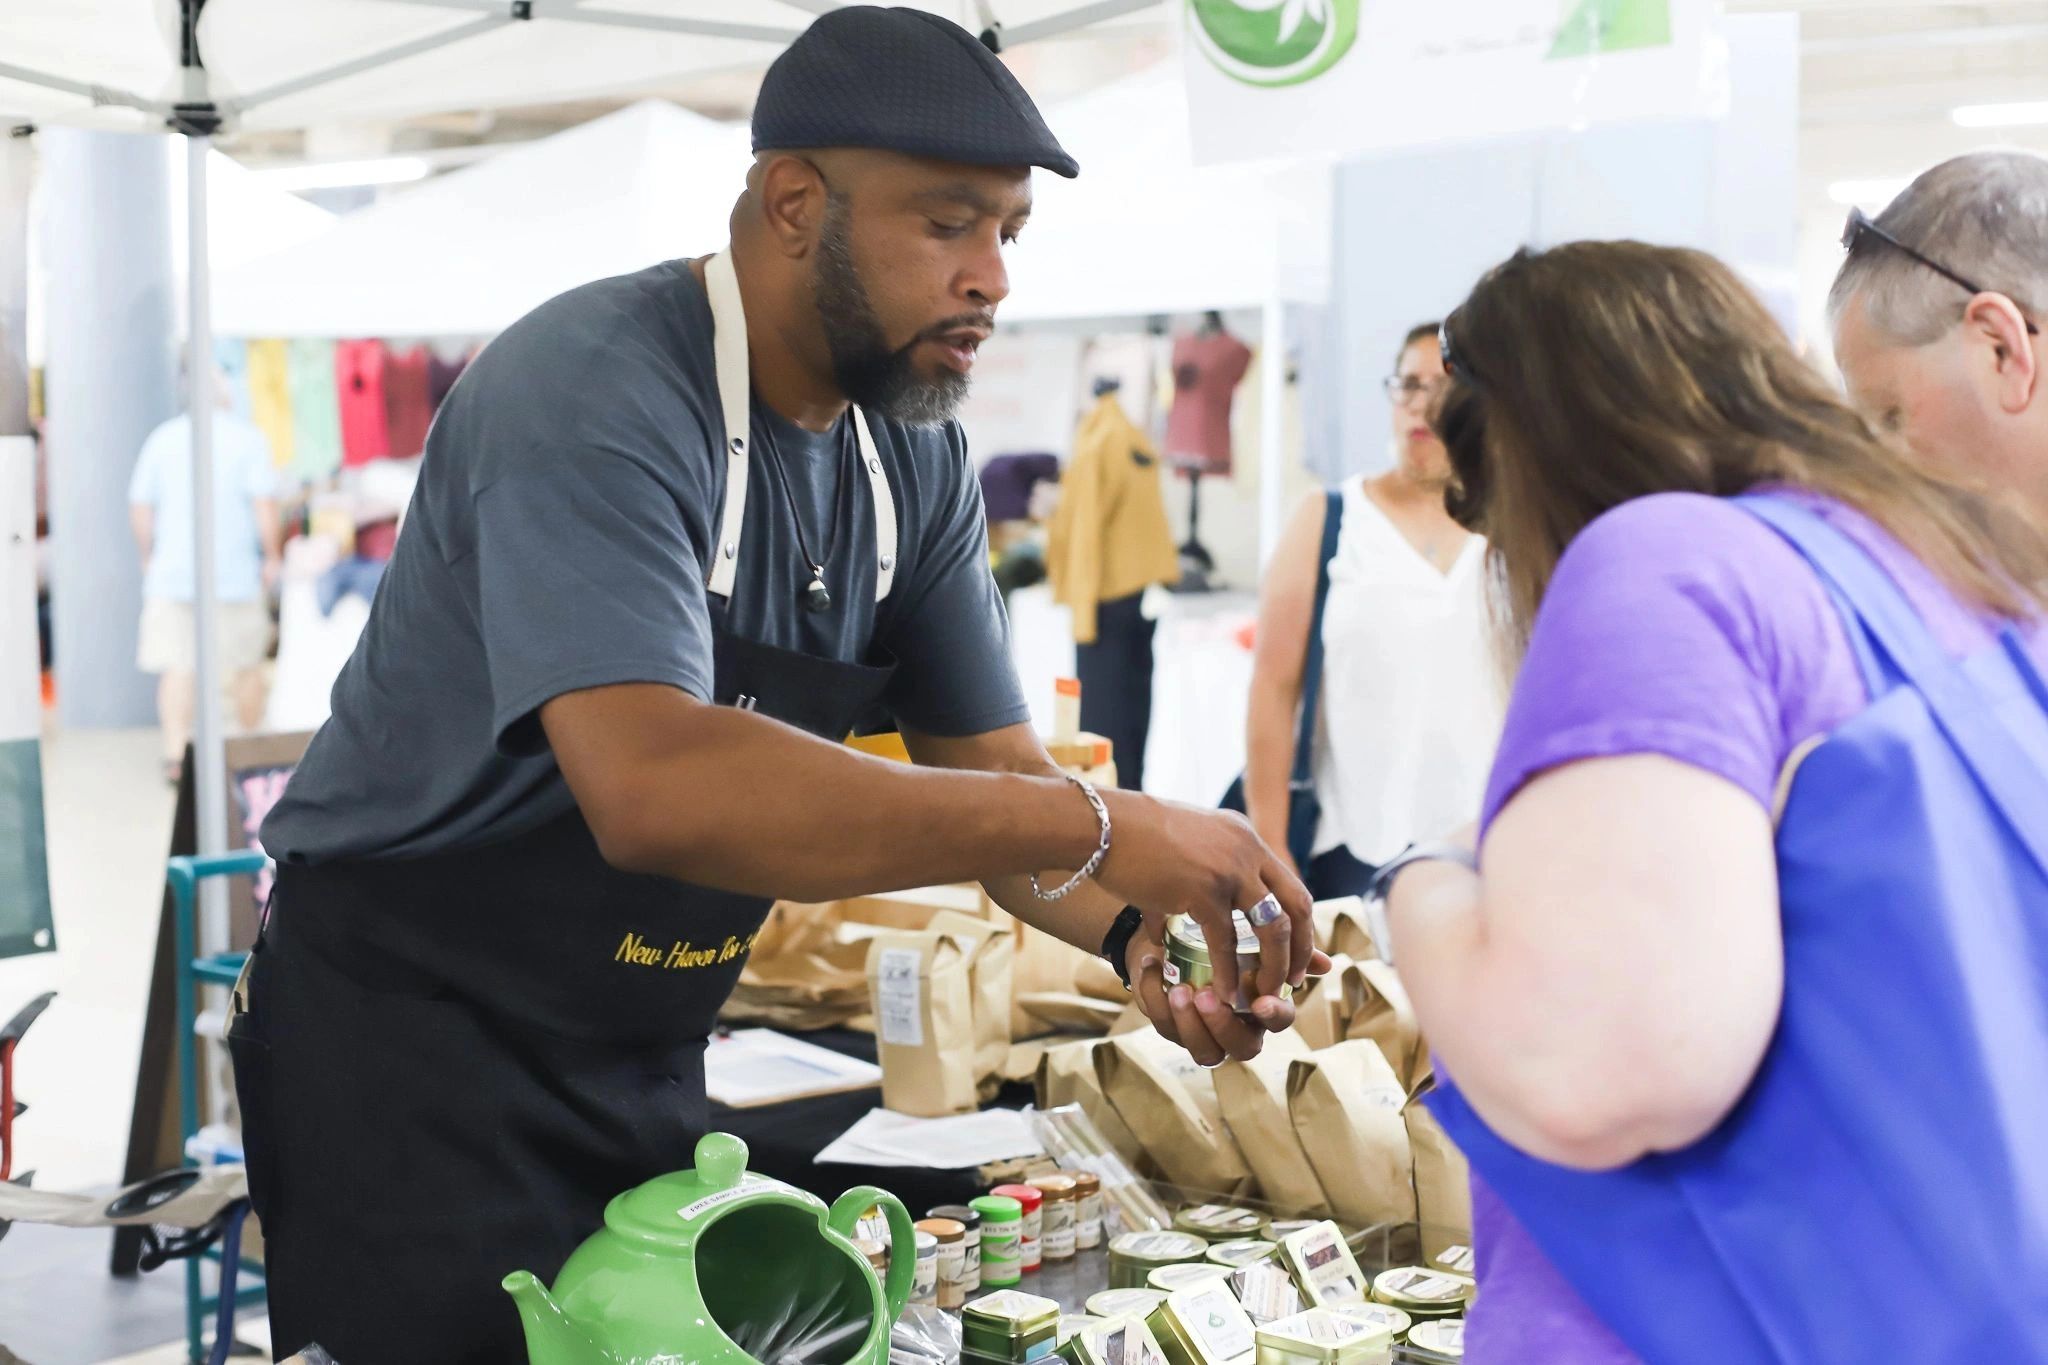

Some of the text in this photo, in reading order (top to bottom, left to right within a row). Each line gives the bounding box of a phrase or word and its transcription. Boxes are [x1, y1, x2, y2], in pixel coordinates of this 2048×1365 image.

[615, 932, 661, 966] New
[664, 941, 716, 968] Haven
[690, 1201, 710, 1213] FREE
